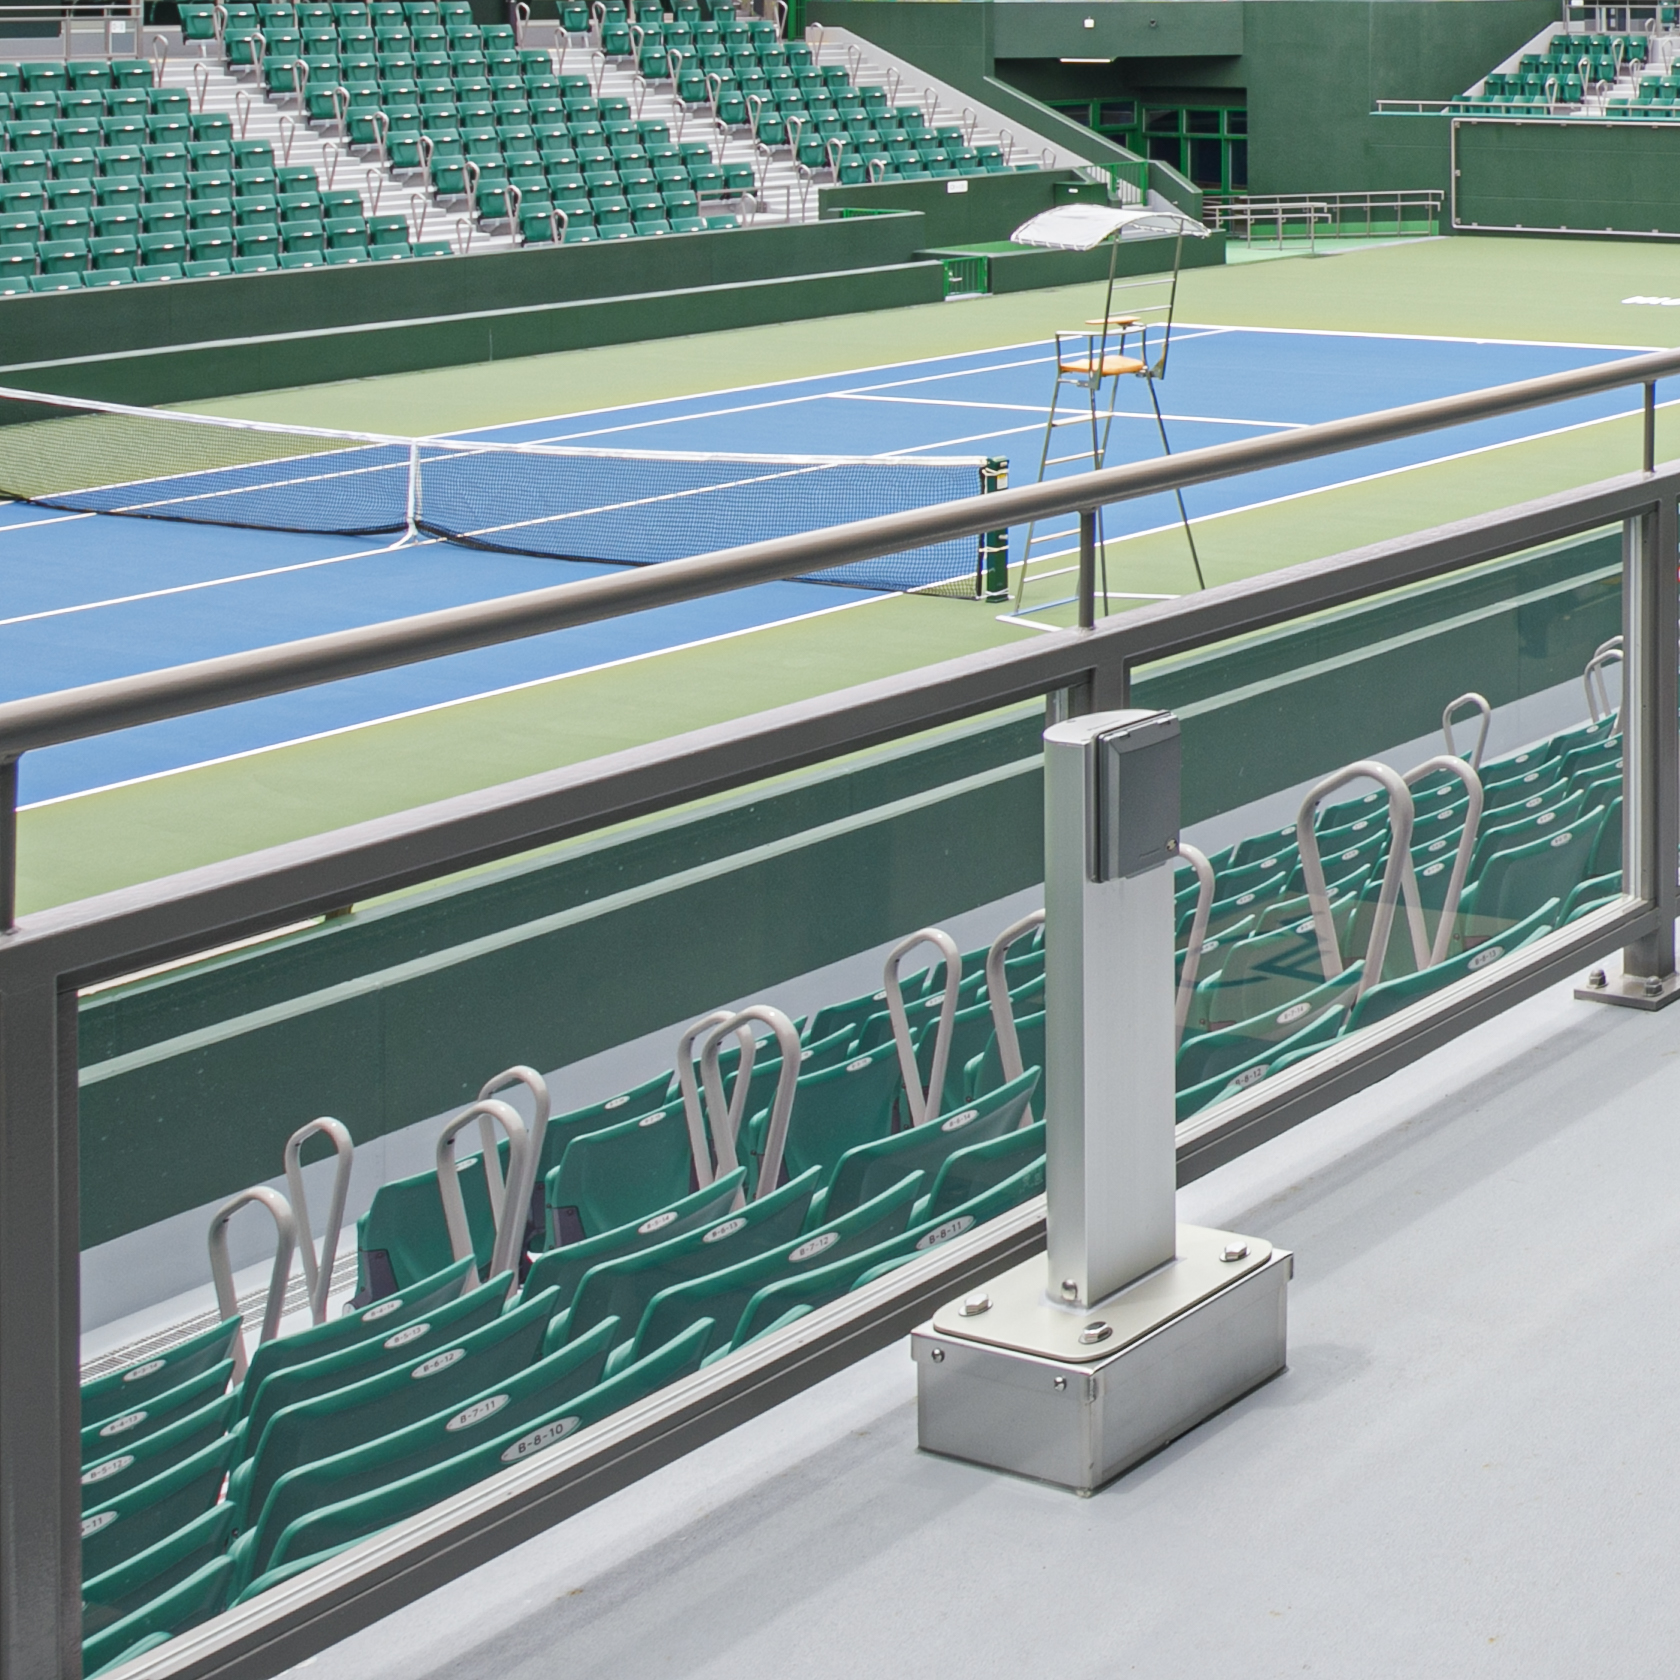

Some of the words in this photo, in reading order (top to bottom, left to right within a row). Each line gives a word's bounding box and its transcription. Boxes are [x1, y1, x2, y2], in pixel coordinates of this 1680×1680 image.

[929, 1221, 961, 1244] B-8-11
[799, 1236, 828, 1256] B-7-12
[423, 1353, 454, 1372] B-6-12
[459, 1401, 496, 1424] B-7-11
[518, 1423, 563, 1454] B-8-10
[90, 1459, 123, 1479] B-5-12
